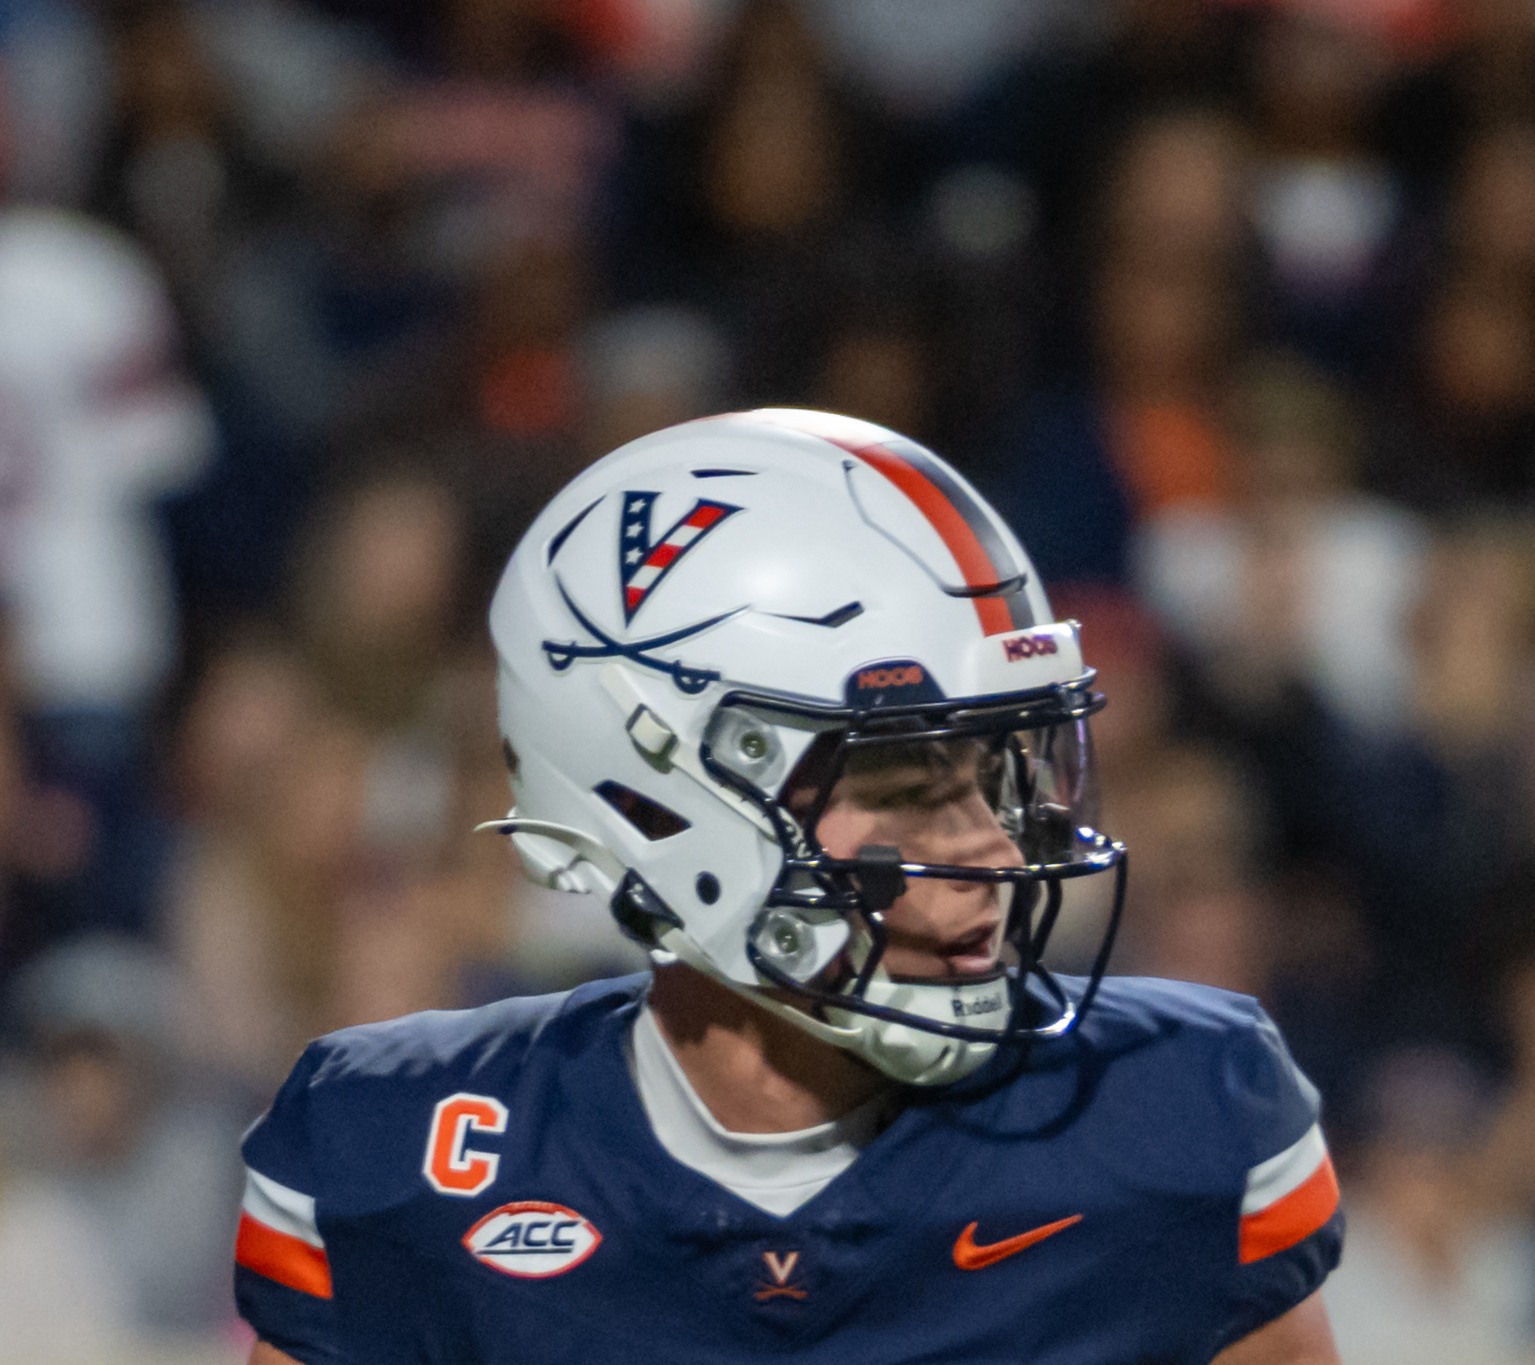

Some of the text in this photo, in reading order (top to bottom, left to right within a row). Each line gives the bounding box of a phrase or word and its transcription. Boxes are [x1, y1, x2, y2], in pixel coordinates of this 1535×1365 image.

[858, 666, 923, 689] HOOS
[422, 1092, 510, 1197] C
[484, 1221, 581, 1248] ACC
[763, 1250, 799, 1286] V
